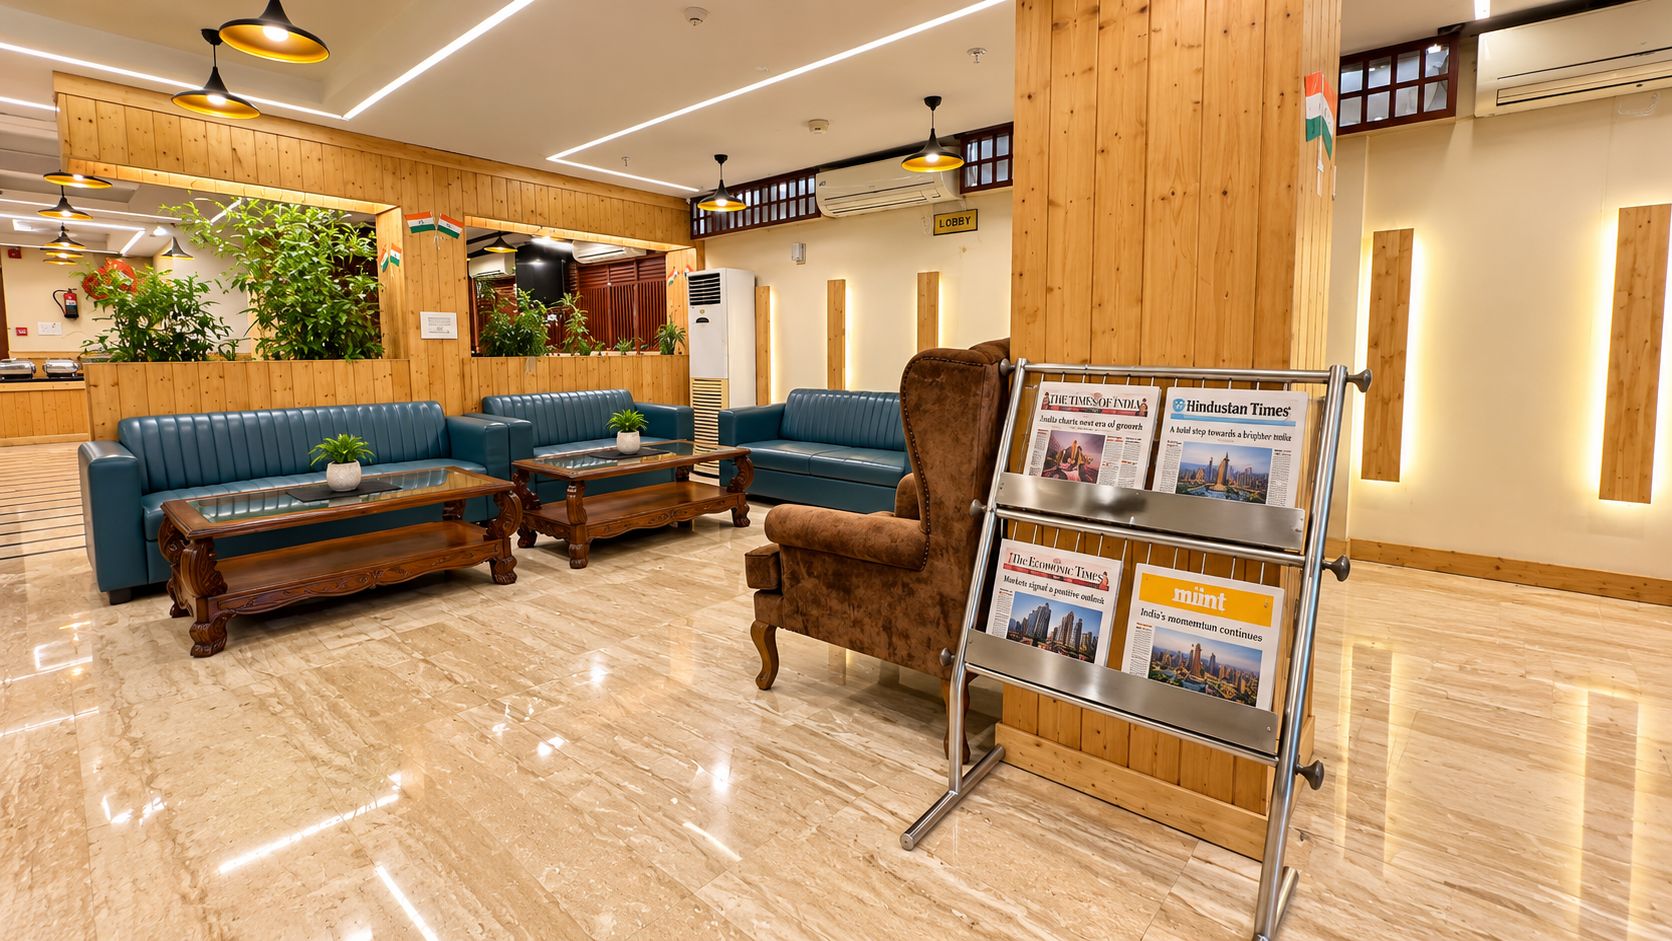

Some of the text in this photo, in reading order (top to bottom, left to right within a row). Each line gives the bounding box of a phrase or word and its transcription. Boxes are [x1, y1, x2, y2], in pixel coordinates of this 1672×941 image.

[939, 216, 971, 228] LOBBY
[1049, 394, 1140, 409] THE TIMES OF INDIA
[1186, 399, 1289, 417] Hindustan Times
[1095, 420, 1106, 428] era
[1169, 425, 1175, 433] A
[1192, 428, 1207, 438] step
[1208, 428, 1236, 438] towards
[1140, 607, 1166, 621] India's
[1219, 627, 1263, 642] continues
